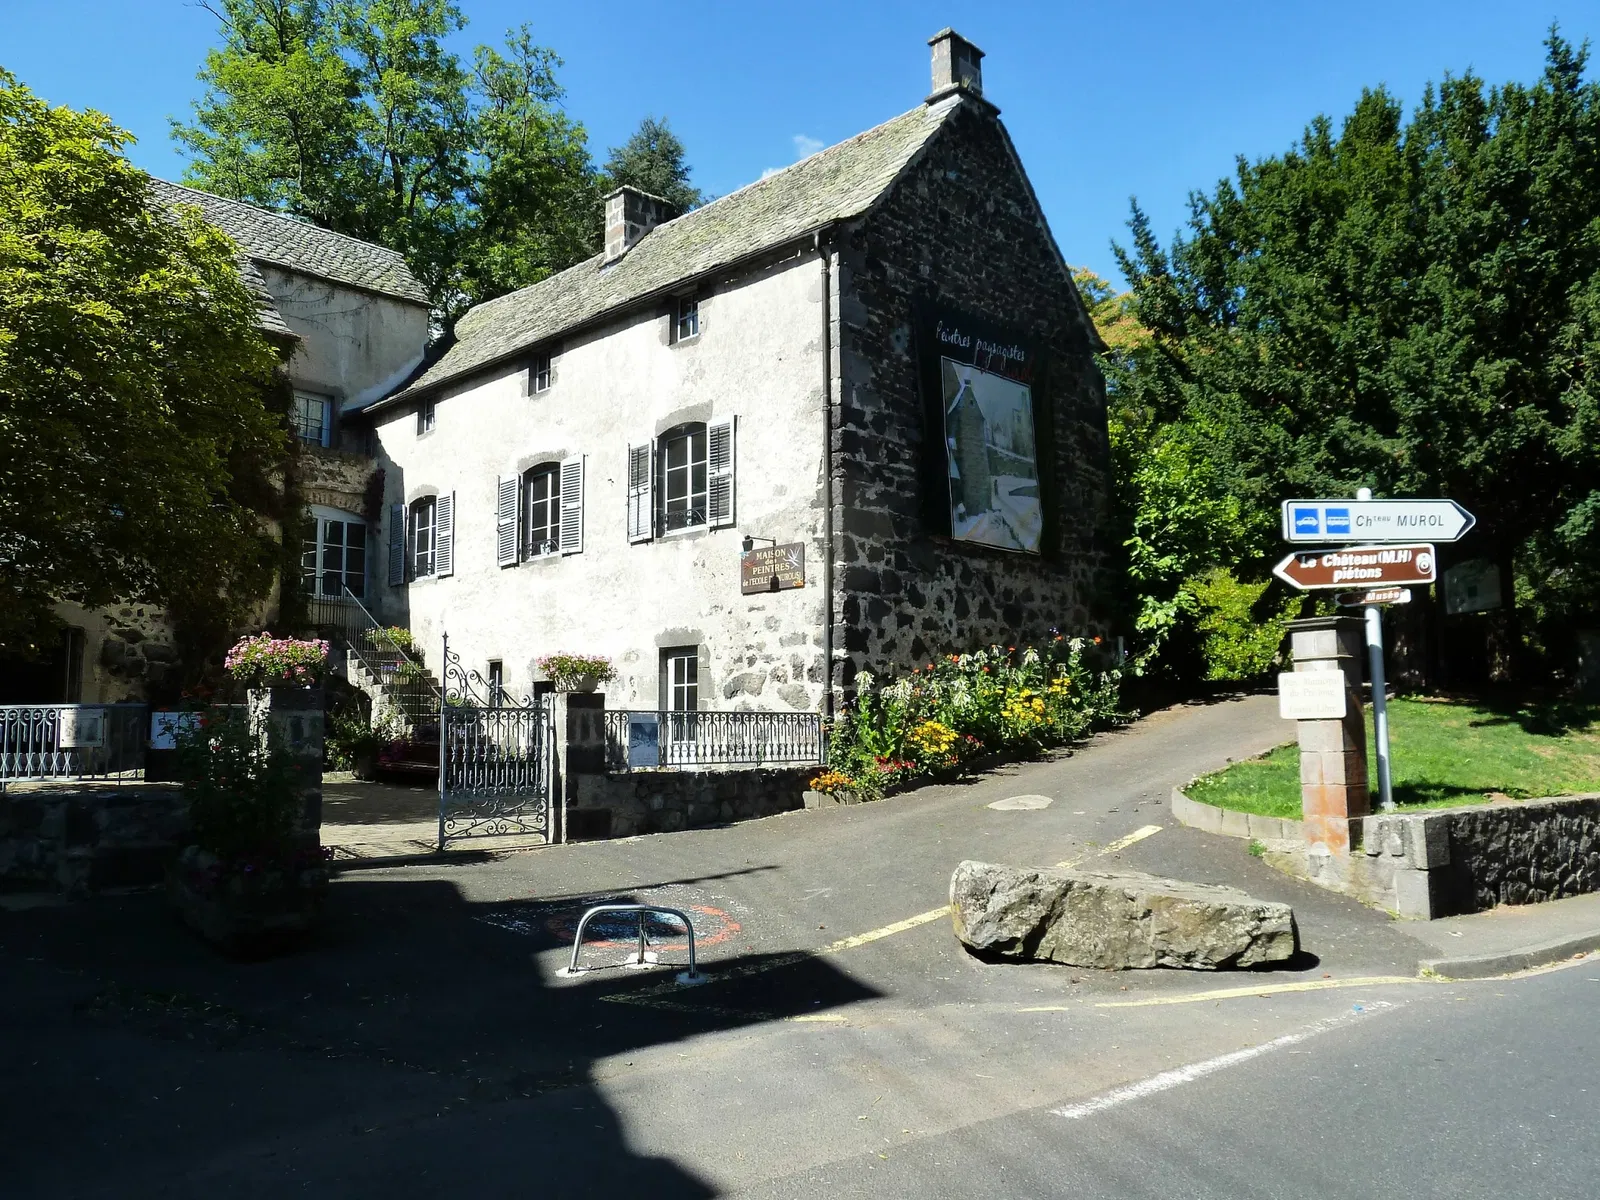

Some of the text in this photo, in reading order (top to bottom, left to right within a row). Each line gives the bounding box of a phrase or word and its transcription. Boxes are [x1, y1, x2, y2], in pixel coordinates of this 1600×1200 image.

[936, 320, 971, 348] Peintres
[973, 338, 1025, 371] paysagistes
[1397, 514, 1445, 527] MUROL
[756, 548, 786, 561] MAISON
[1300, 556, 1317, 568] Le
[1322, 552, 1377, 567] Château
[752, 562, 790, 575] PEINTRES
[1333, 566, 1383, 583] piétons
[1365, 590, 1401, 601] Musée
